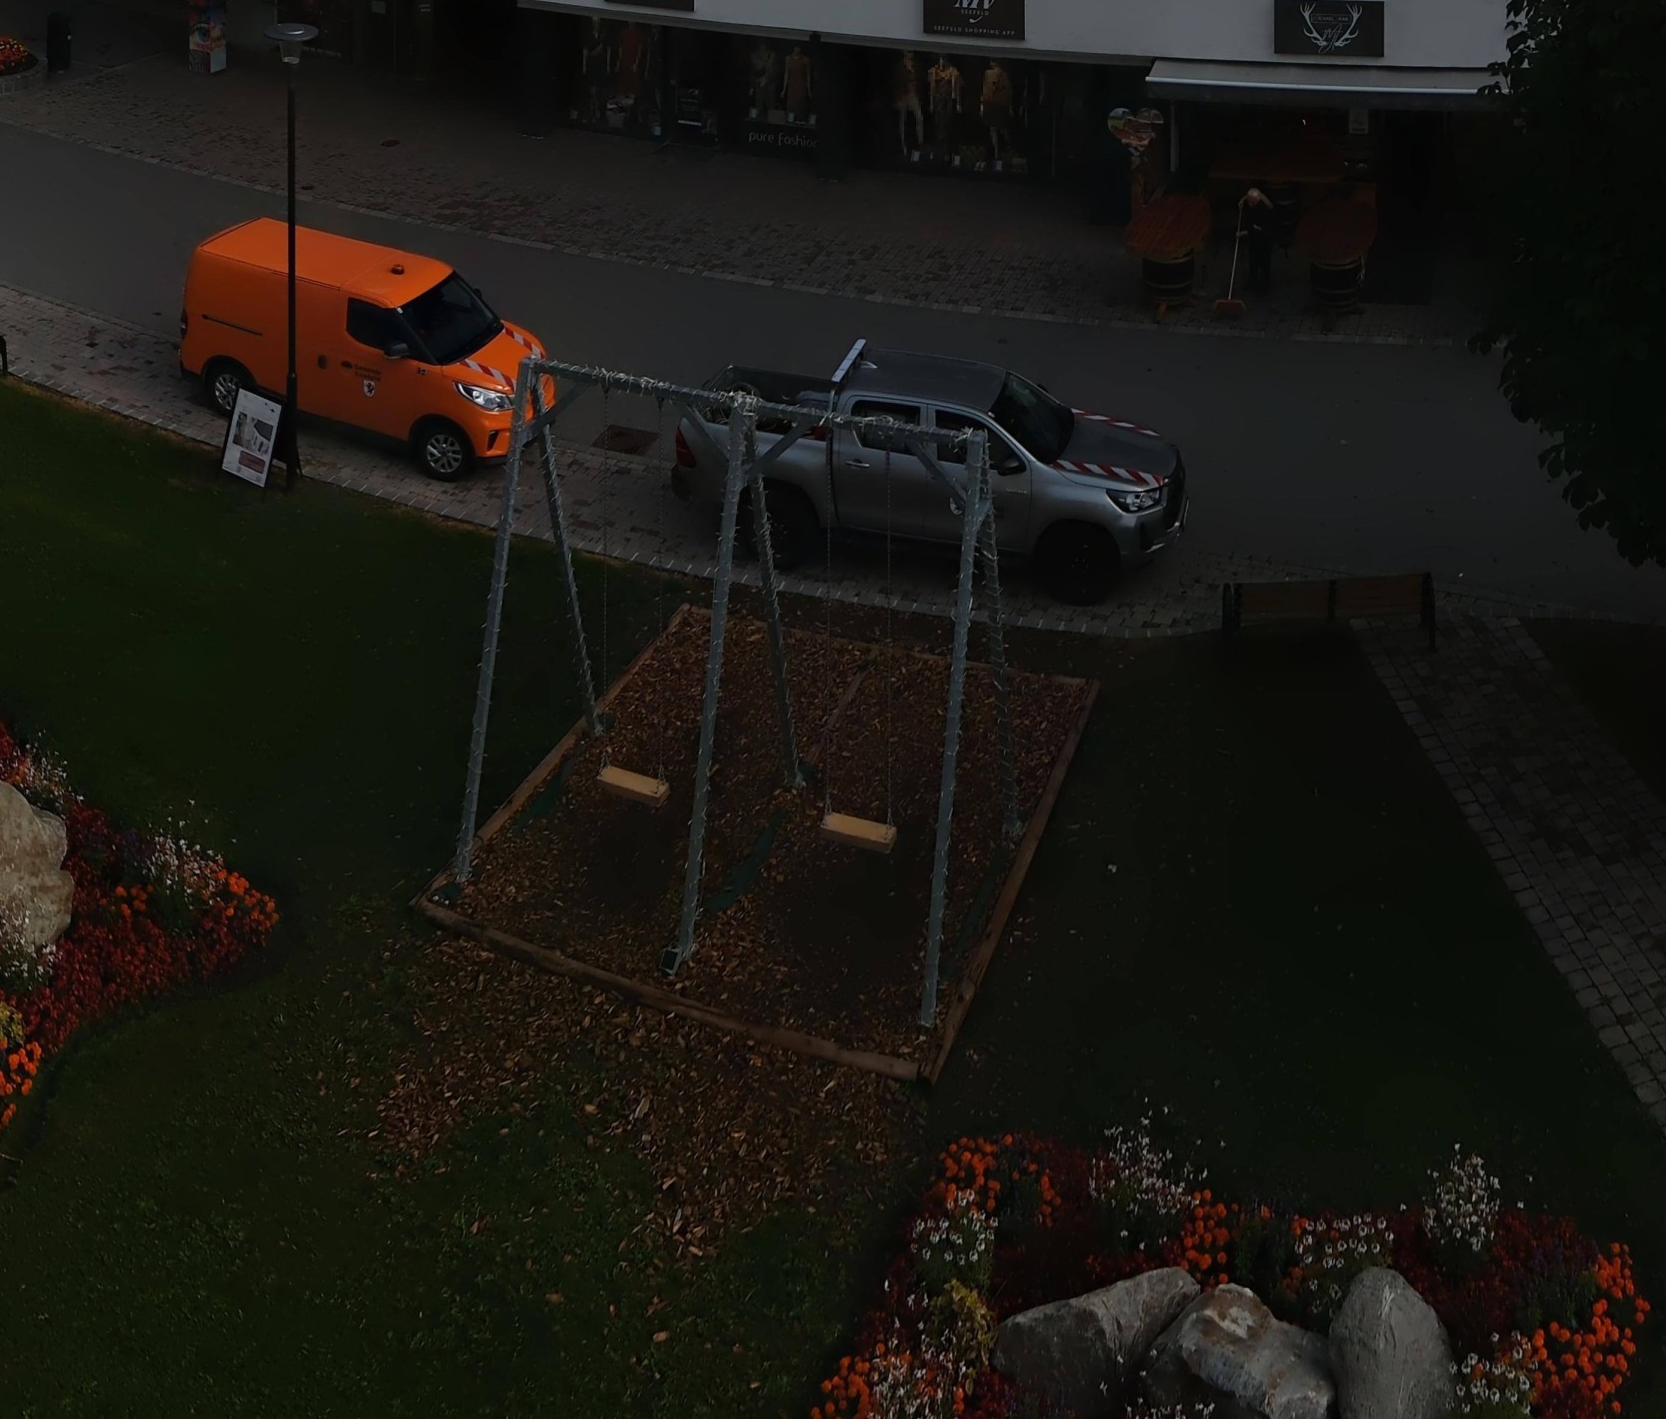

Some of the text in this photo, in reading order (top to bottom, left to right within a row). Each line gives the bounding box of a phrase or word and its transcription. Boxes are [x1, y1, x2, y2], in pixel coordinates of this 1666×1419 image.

[933, 25, 962, 33] SEEFELD
[964, 27, 1000, 35] SHOPPING
[748, 131, 774, 144] pure
